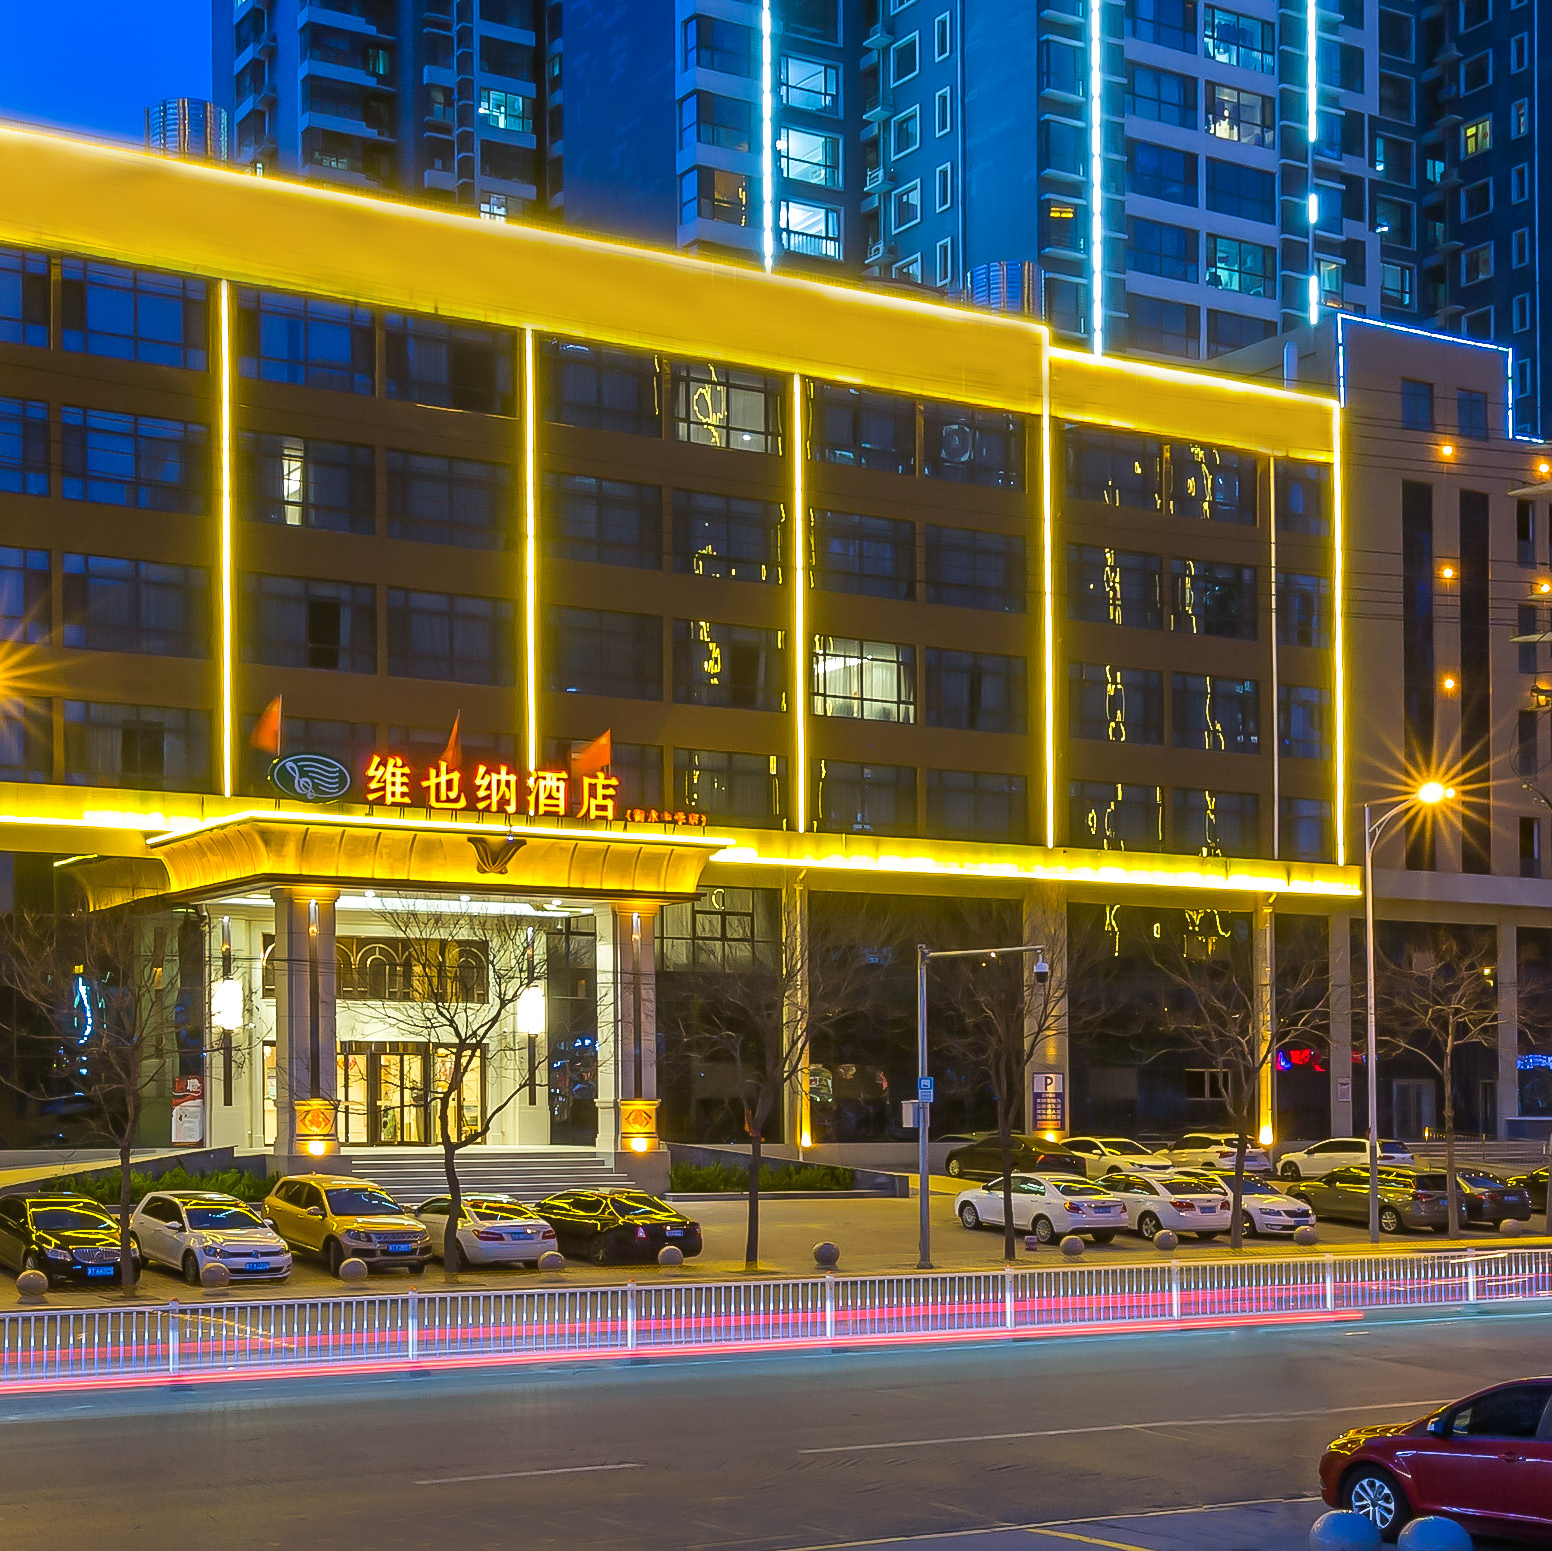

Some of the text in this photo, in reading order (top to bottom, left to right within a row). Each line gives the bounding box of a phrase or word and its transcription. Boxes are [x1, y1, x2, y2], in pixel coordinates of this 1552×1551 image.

[365, 754, 620, 821] 维也纳酒店
[1044, 1075, 1054, 1092] P
